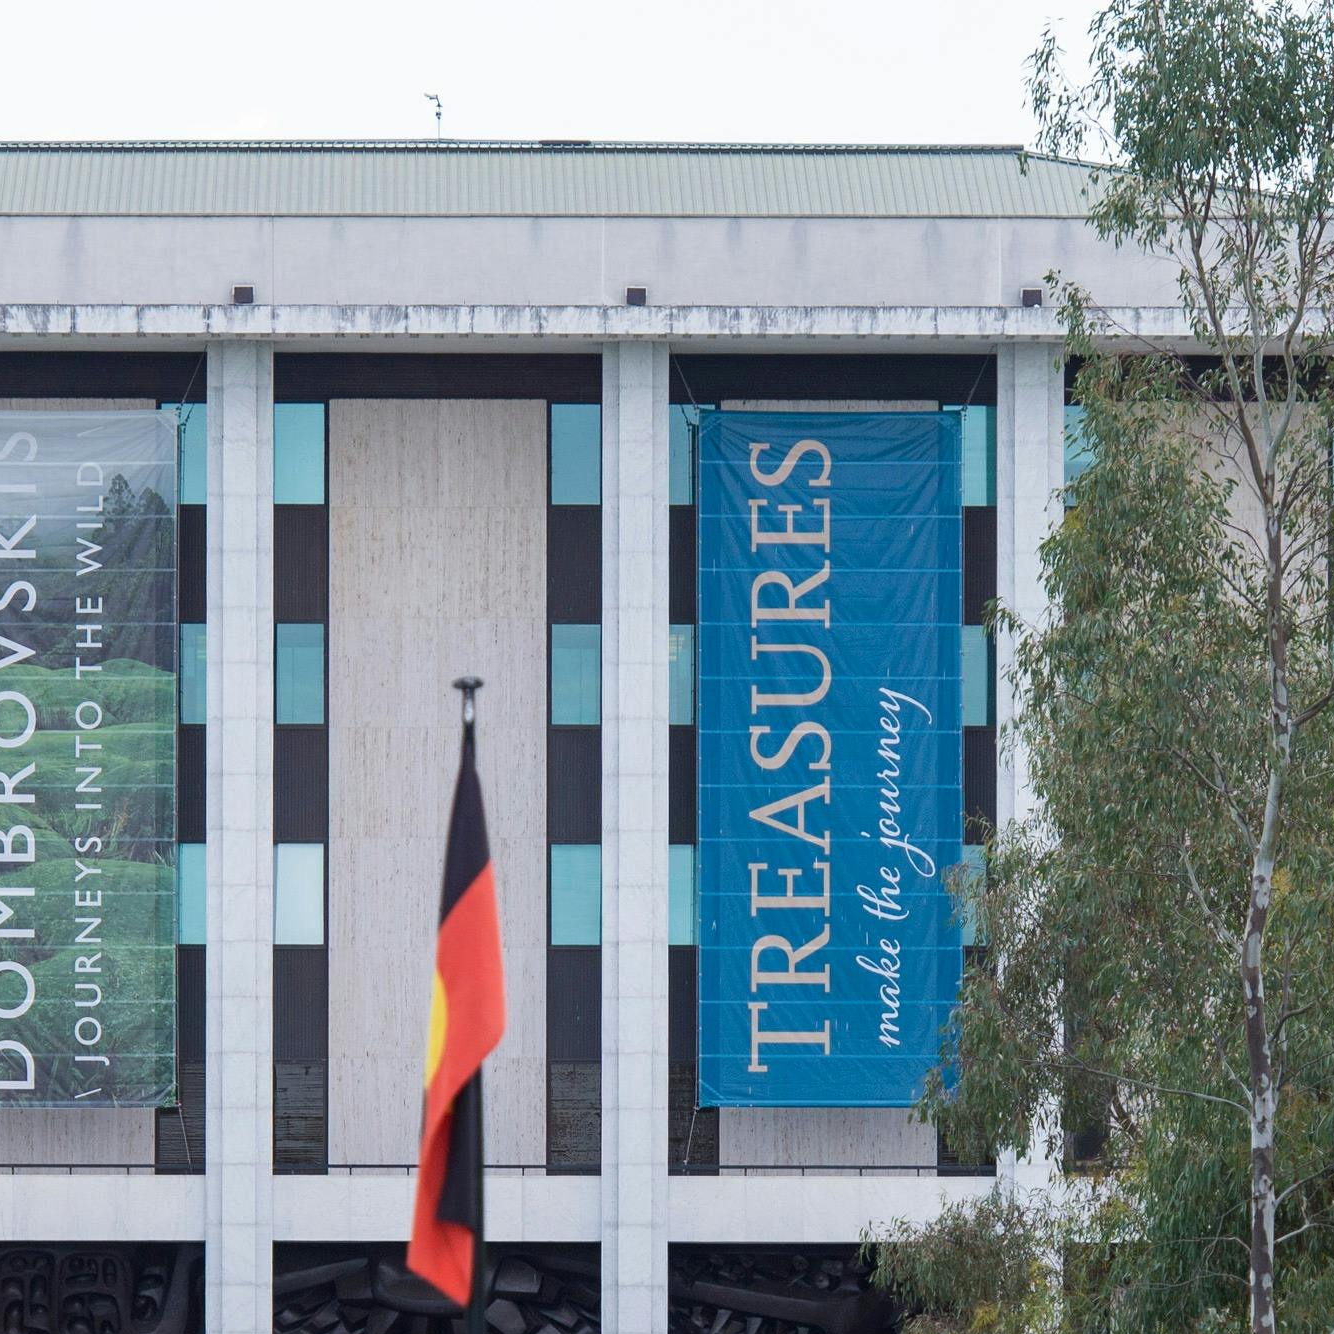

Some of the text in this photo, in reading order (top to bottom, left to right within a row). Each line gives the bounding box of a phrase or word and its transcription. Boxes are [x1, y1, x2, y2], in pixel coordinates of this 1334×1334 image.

[75, 461, 105, 577] WILD
[74, 595, 104, 680] THE
[74, 701, 104, 809] INTO
[747, 438, 832, 1073] TREASURES
[74, 835, 109, 1067] JOURNEYS
[855, 686, 936, 1049] make the journey
